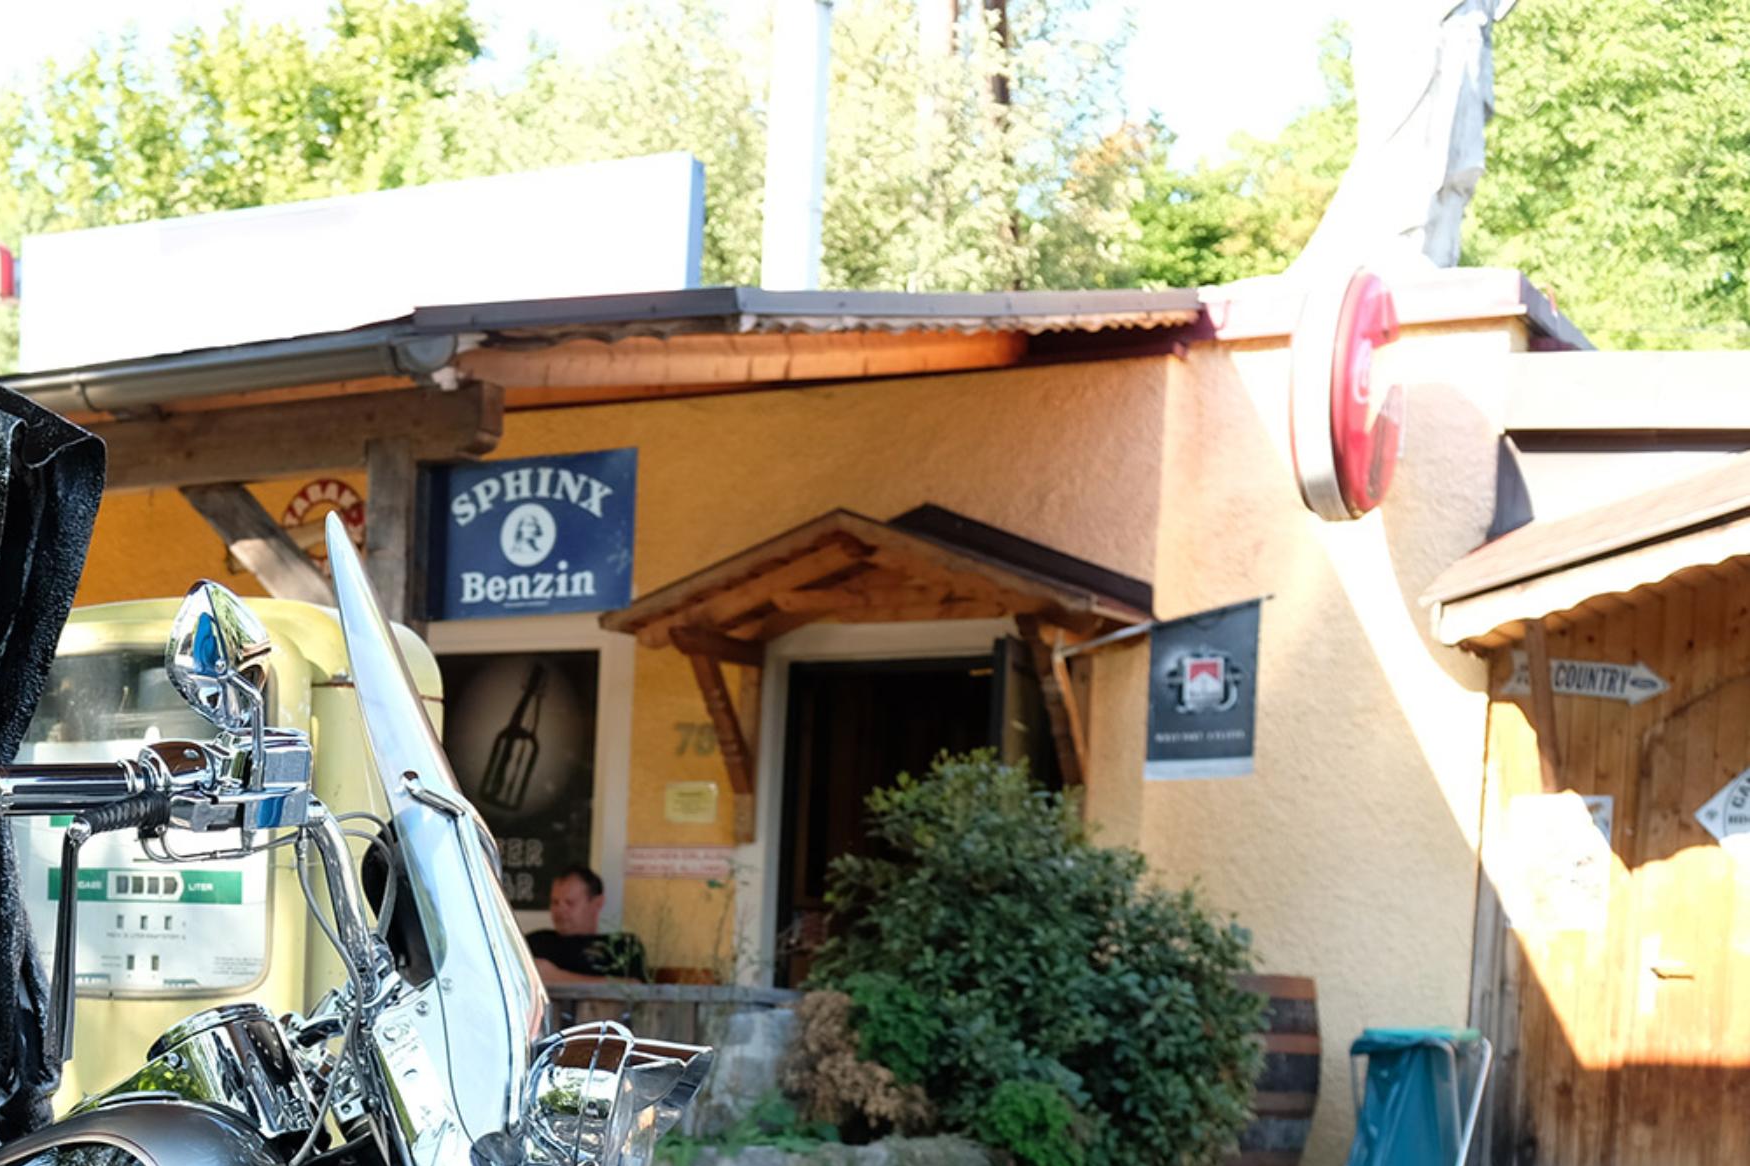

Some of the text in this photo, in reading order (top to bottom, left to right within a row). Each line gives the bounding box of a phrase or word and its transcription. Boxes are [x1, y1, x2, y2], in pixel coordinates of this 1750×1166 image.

[451, 467, 613, 527] SPHINX
[460, 560, 596, 603] Benzin
[1555, 662, 1631, 693] COUNTRY
